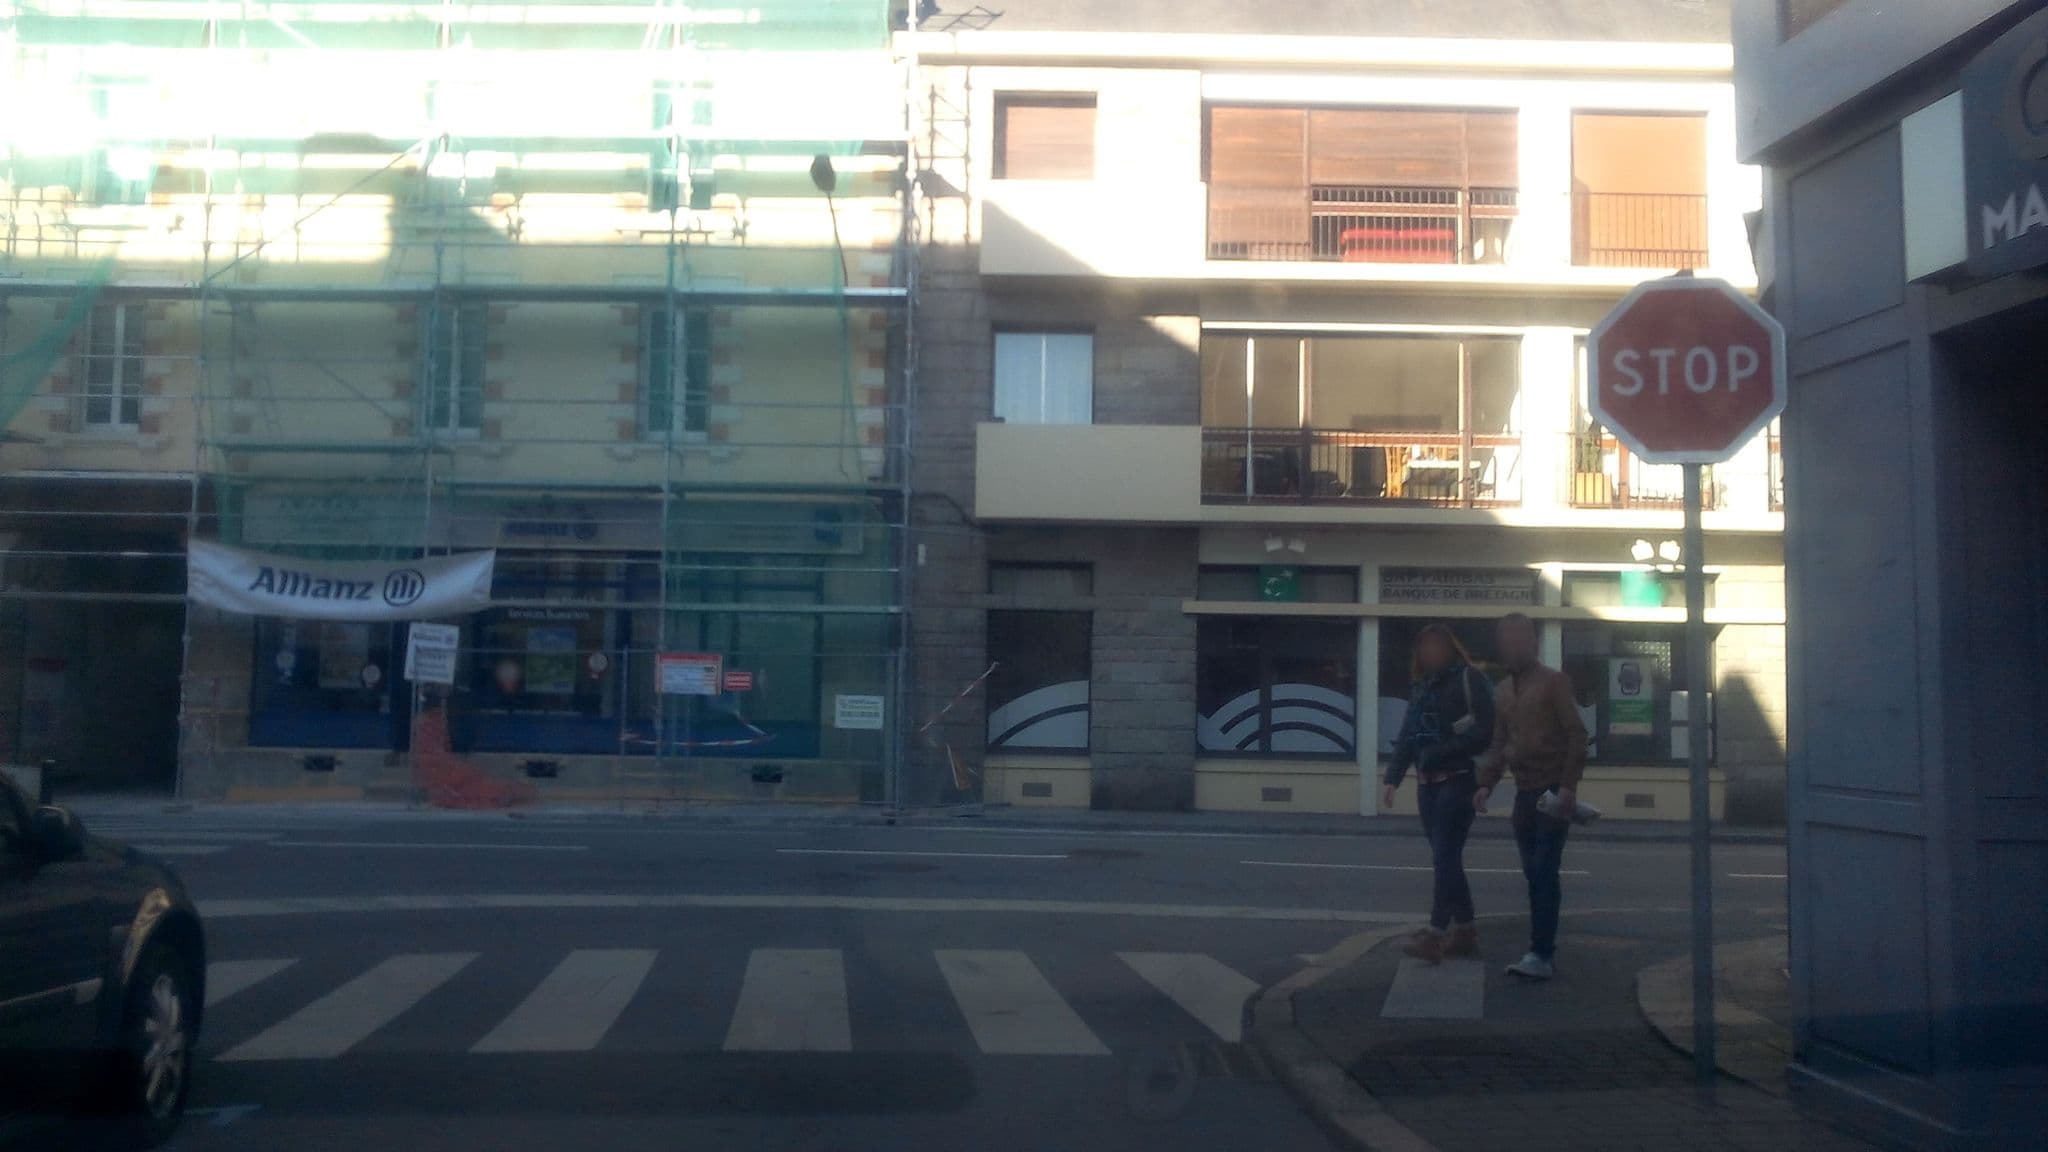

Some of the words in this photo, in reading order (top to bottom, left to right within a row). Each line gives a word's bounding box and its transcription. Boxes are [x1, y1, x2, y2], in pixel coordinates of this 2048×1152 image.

[1613, 345, 1760, 396] STOP
[249, 565, 374, 600] Allianz
[1383, 588, 1440, 602] BANQUE
[1444, 588, 1460, 601] DE
